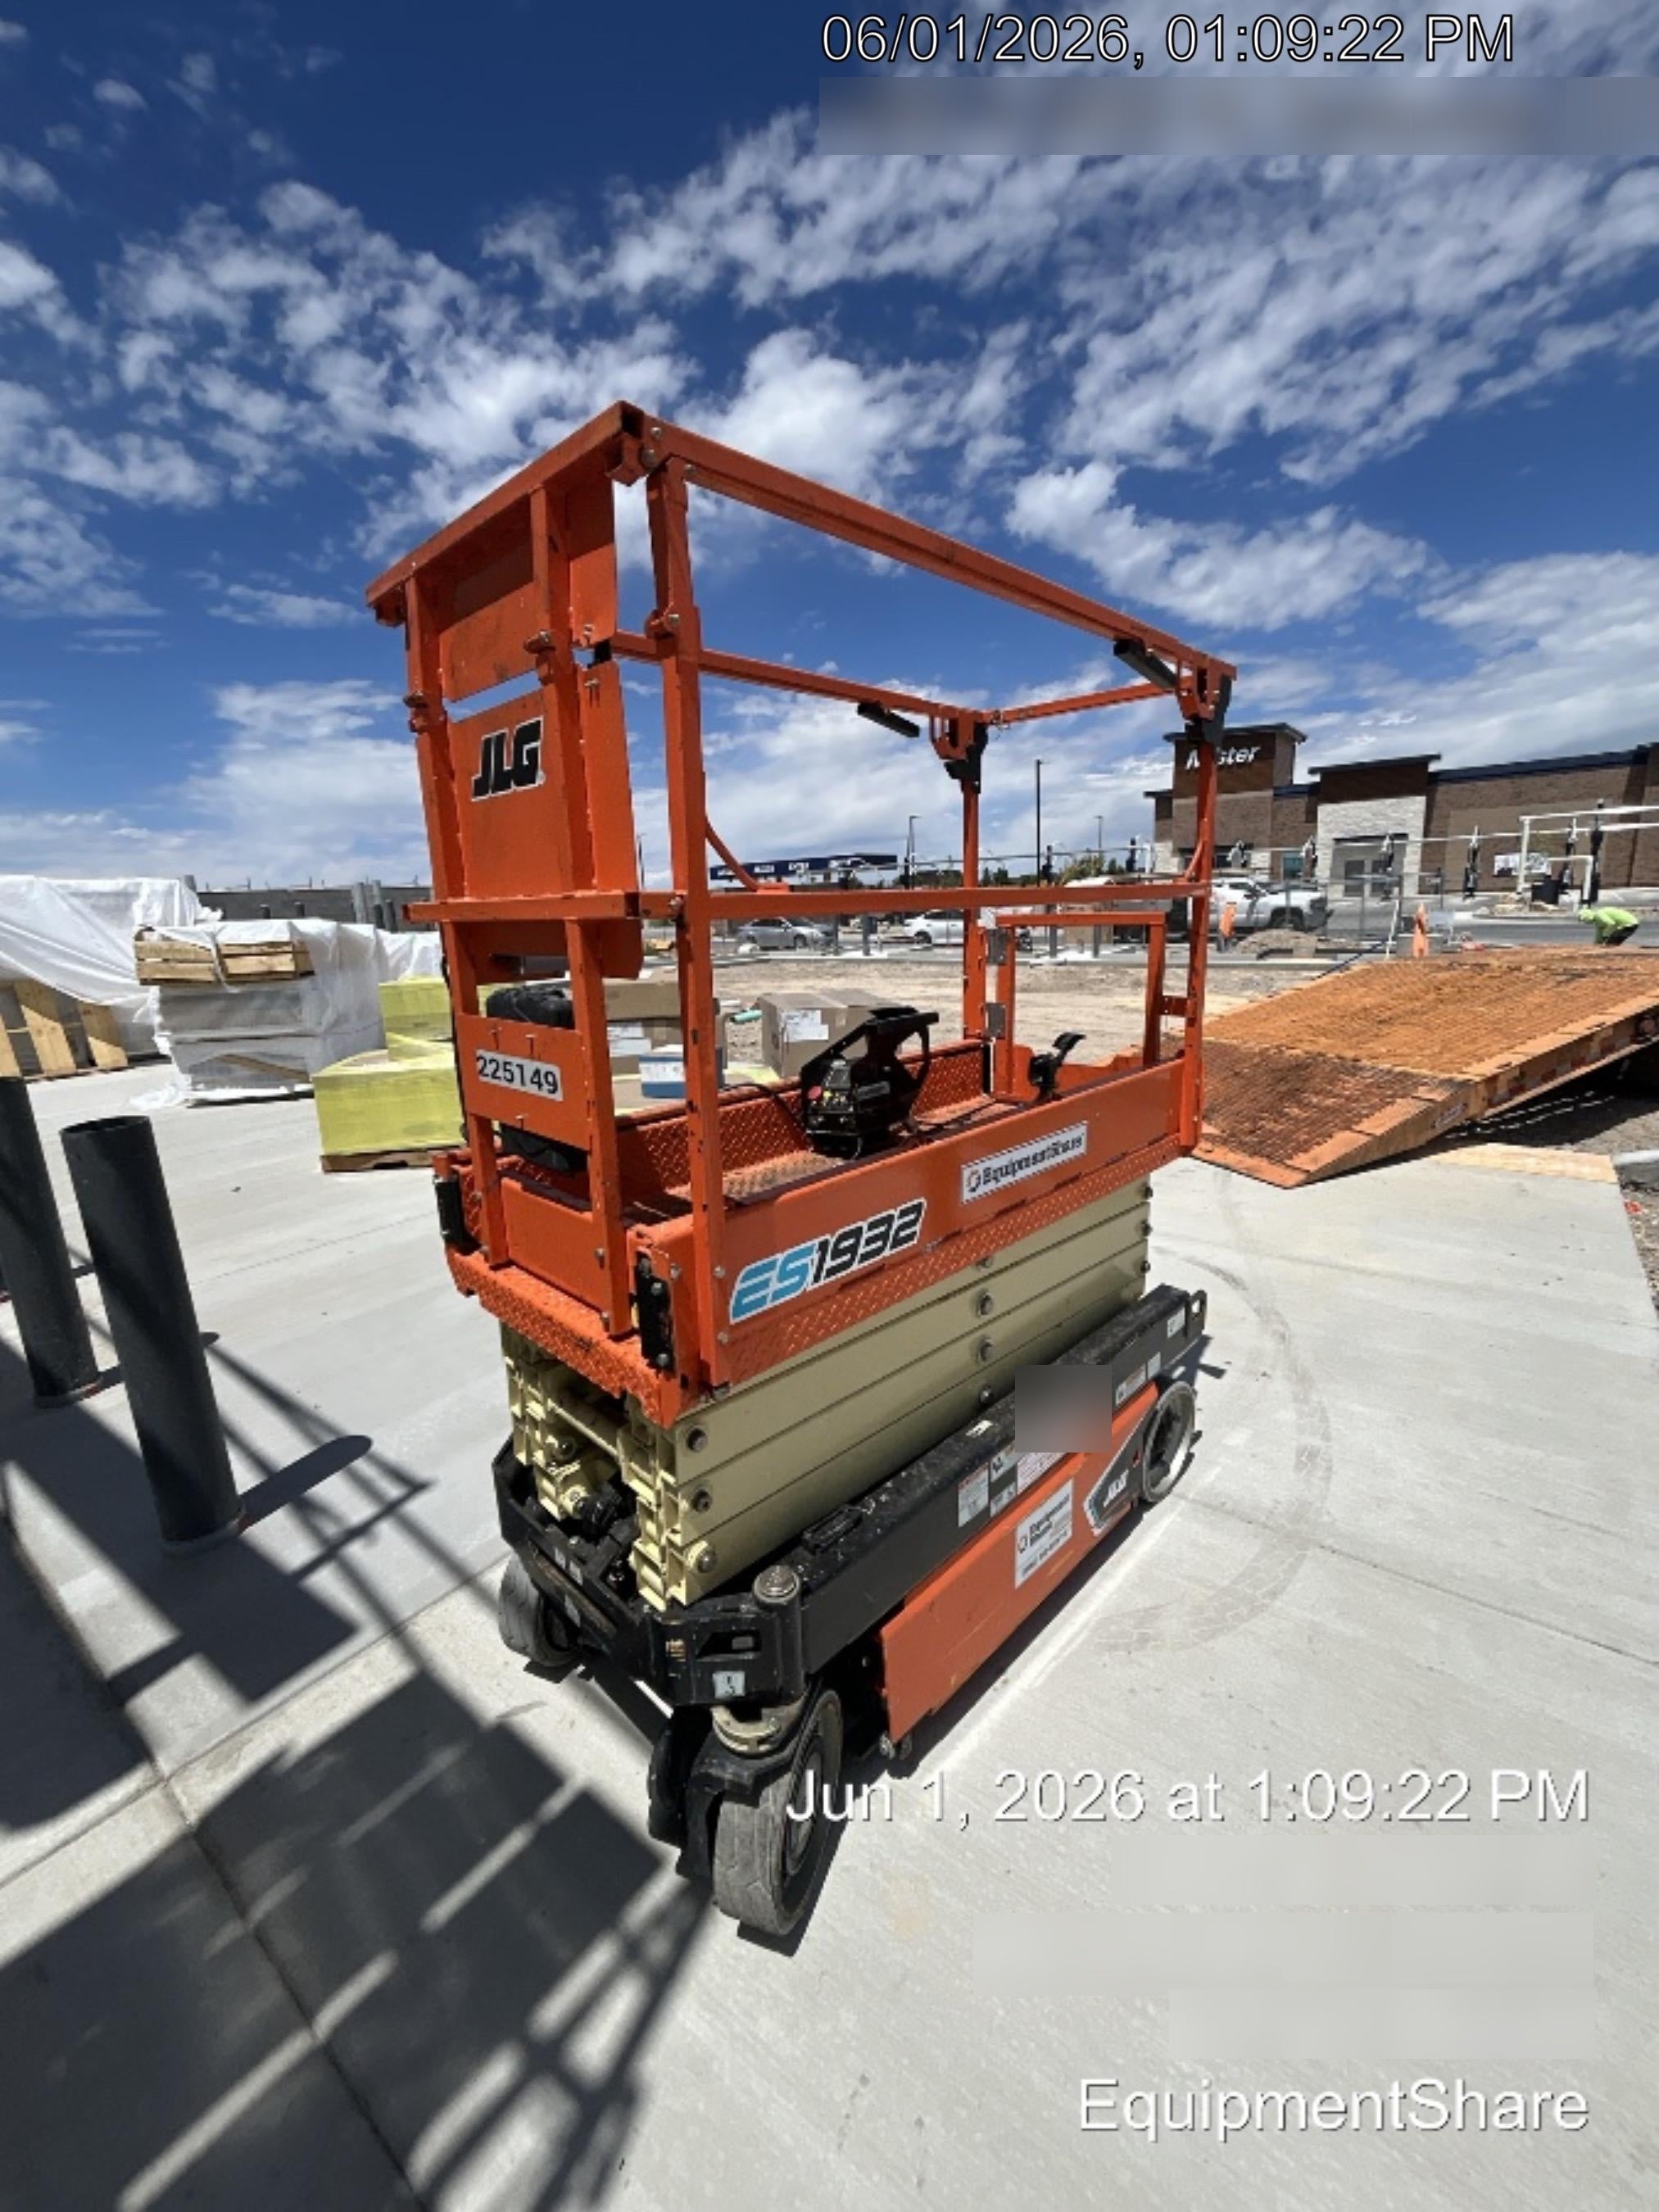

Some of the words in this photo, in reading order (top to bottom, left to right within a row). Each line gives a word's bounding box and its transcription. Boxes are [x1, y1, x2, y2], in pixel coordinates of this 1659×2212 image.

[471, 716, 544, 801] JLG
[1185, 746, 1261, 770] Mster
[476, 1054, 559, 1095] 225149
[729, 1197, 927, 1324] ES1932
